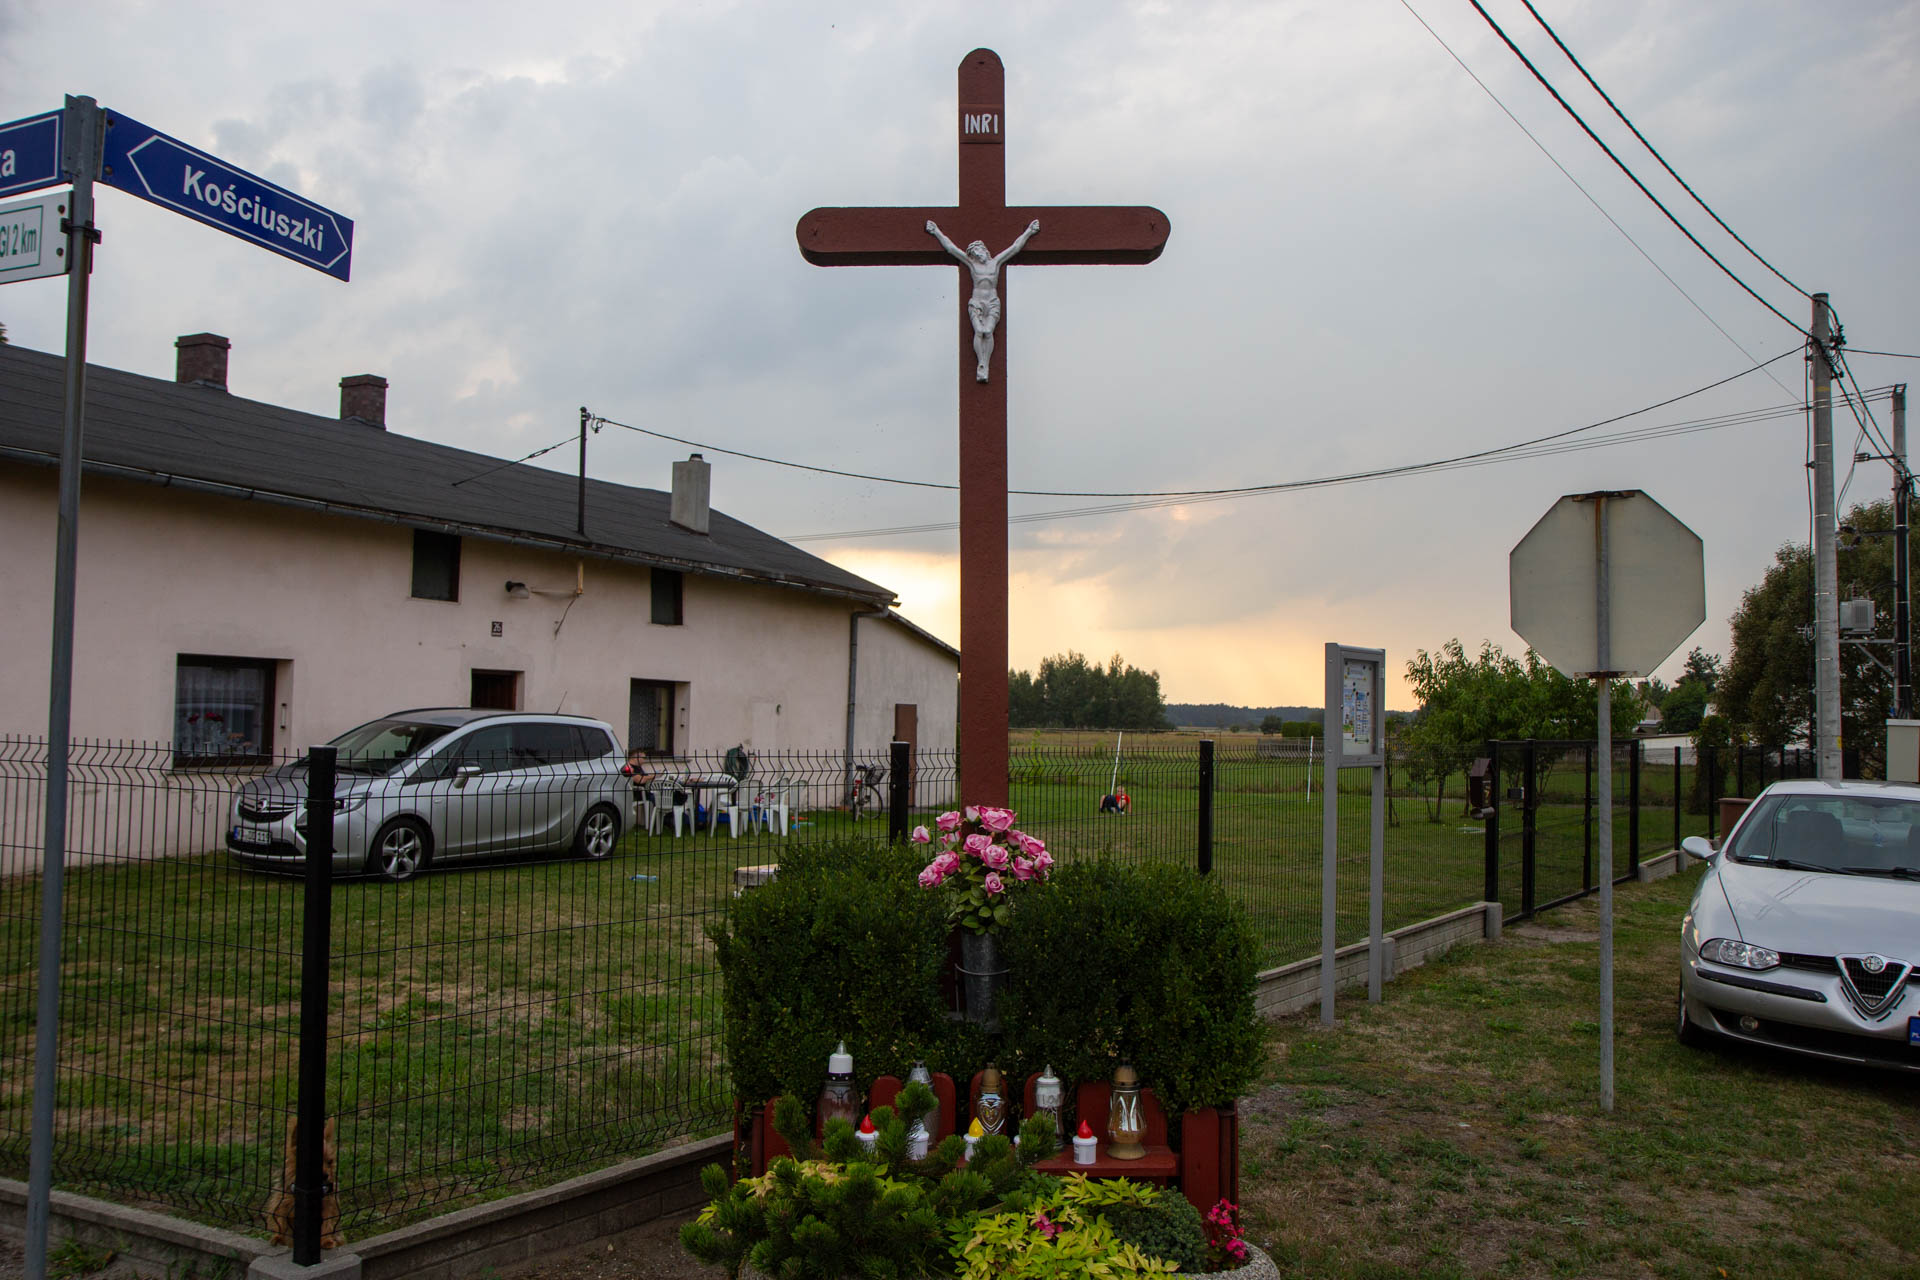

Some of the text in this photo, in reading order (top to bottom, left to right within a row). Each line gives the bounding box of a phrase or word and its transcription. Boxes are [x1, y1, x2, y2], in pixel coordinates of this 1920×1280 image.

[964, 113, 999, 134] INRI
[183, 164, 324, 252] Kościuszki
[12, 223, 19, 256] 2
[21, 222, 37, 254] km
